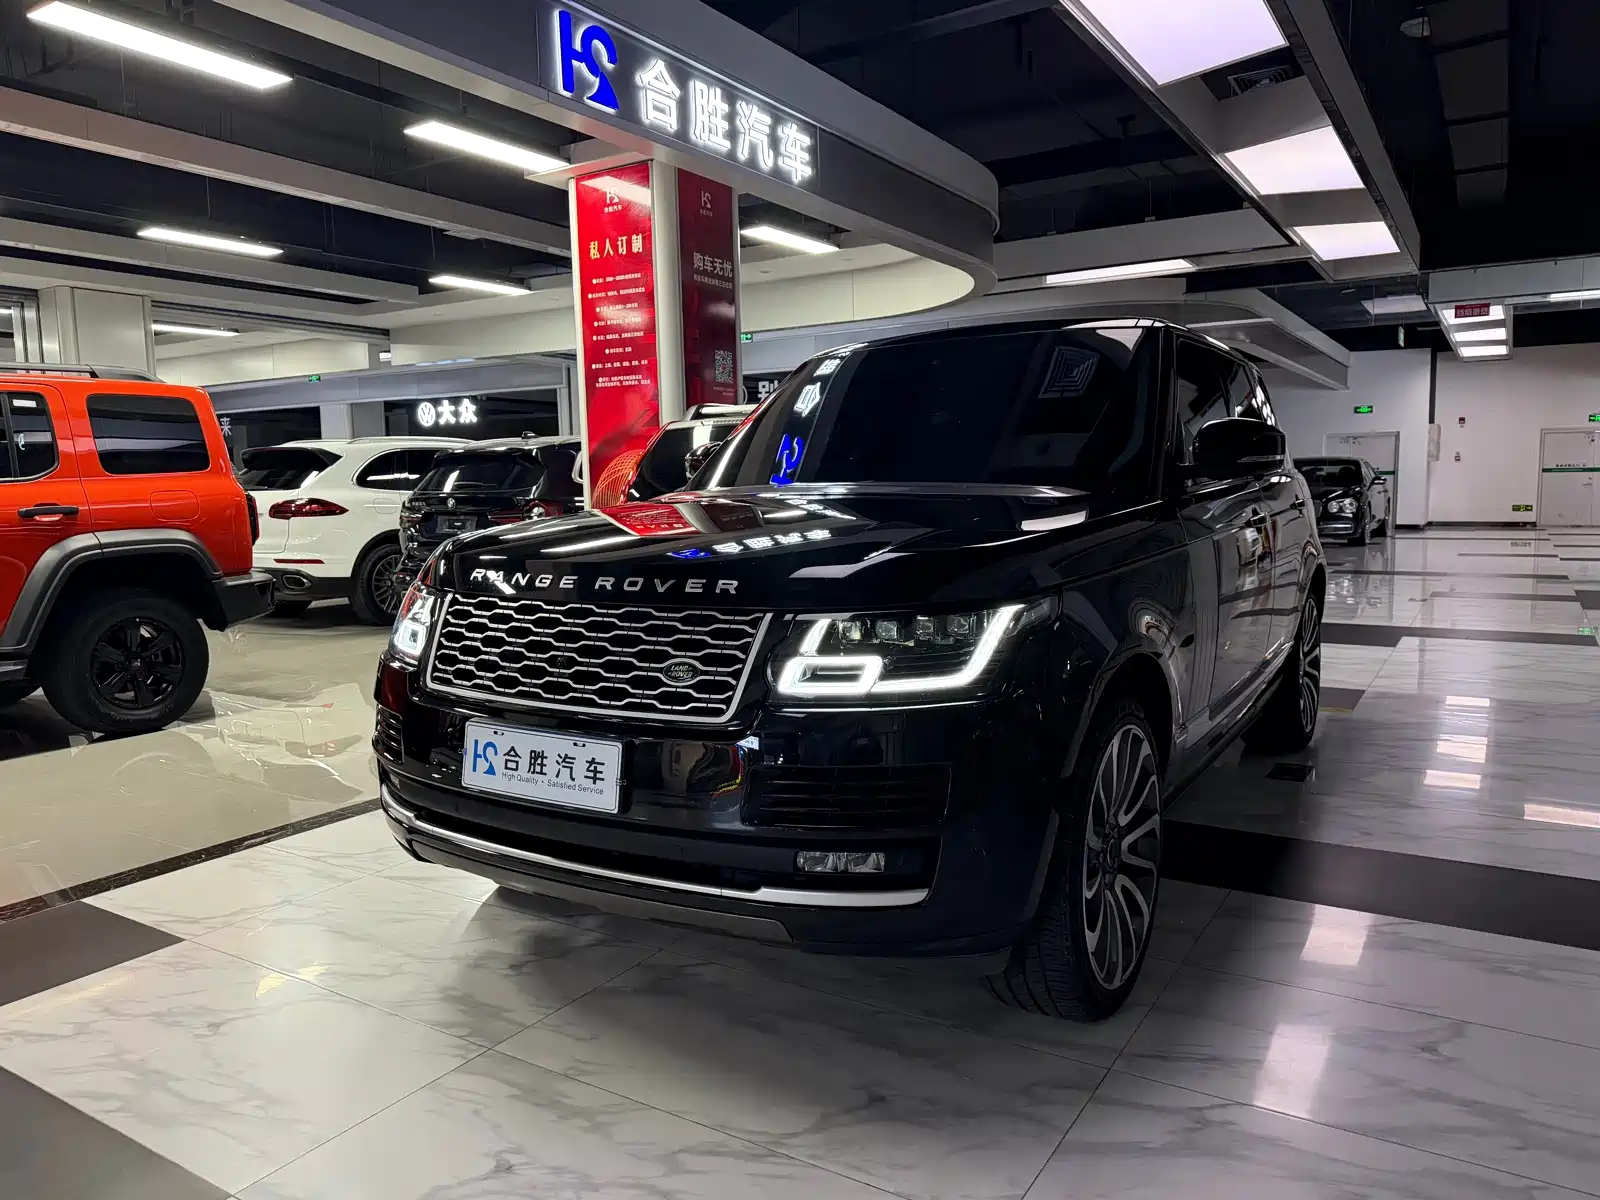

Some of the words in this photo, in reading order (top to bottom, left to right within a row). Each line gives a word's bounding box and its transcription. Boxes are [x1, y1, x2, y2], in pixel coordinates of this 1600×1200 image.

[635, 58, 813, 184] 合胜汽车
[589, 233, 643, 260] 私人订制
[693, 252, 733, 278] 购车无忧
[437, 398, 478, 425] 大众
[219, 416, 232, 437] 来
[470, 568, 578, 590] RANGE
[595, 576, 739, 595] ROVER
[502, 745, 606, 786] 合胜汽车
[502, 772, 515, 784] High
[517, 773, 539, 786] Quality
[547, 779, 576, 791] Satisfied
[577, 784, 604, 795] Service
